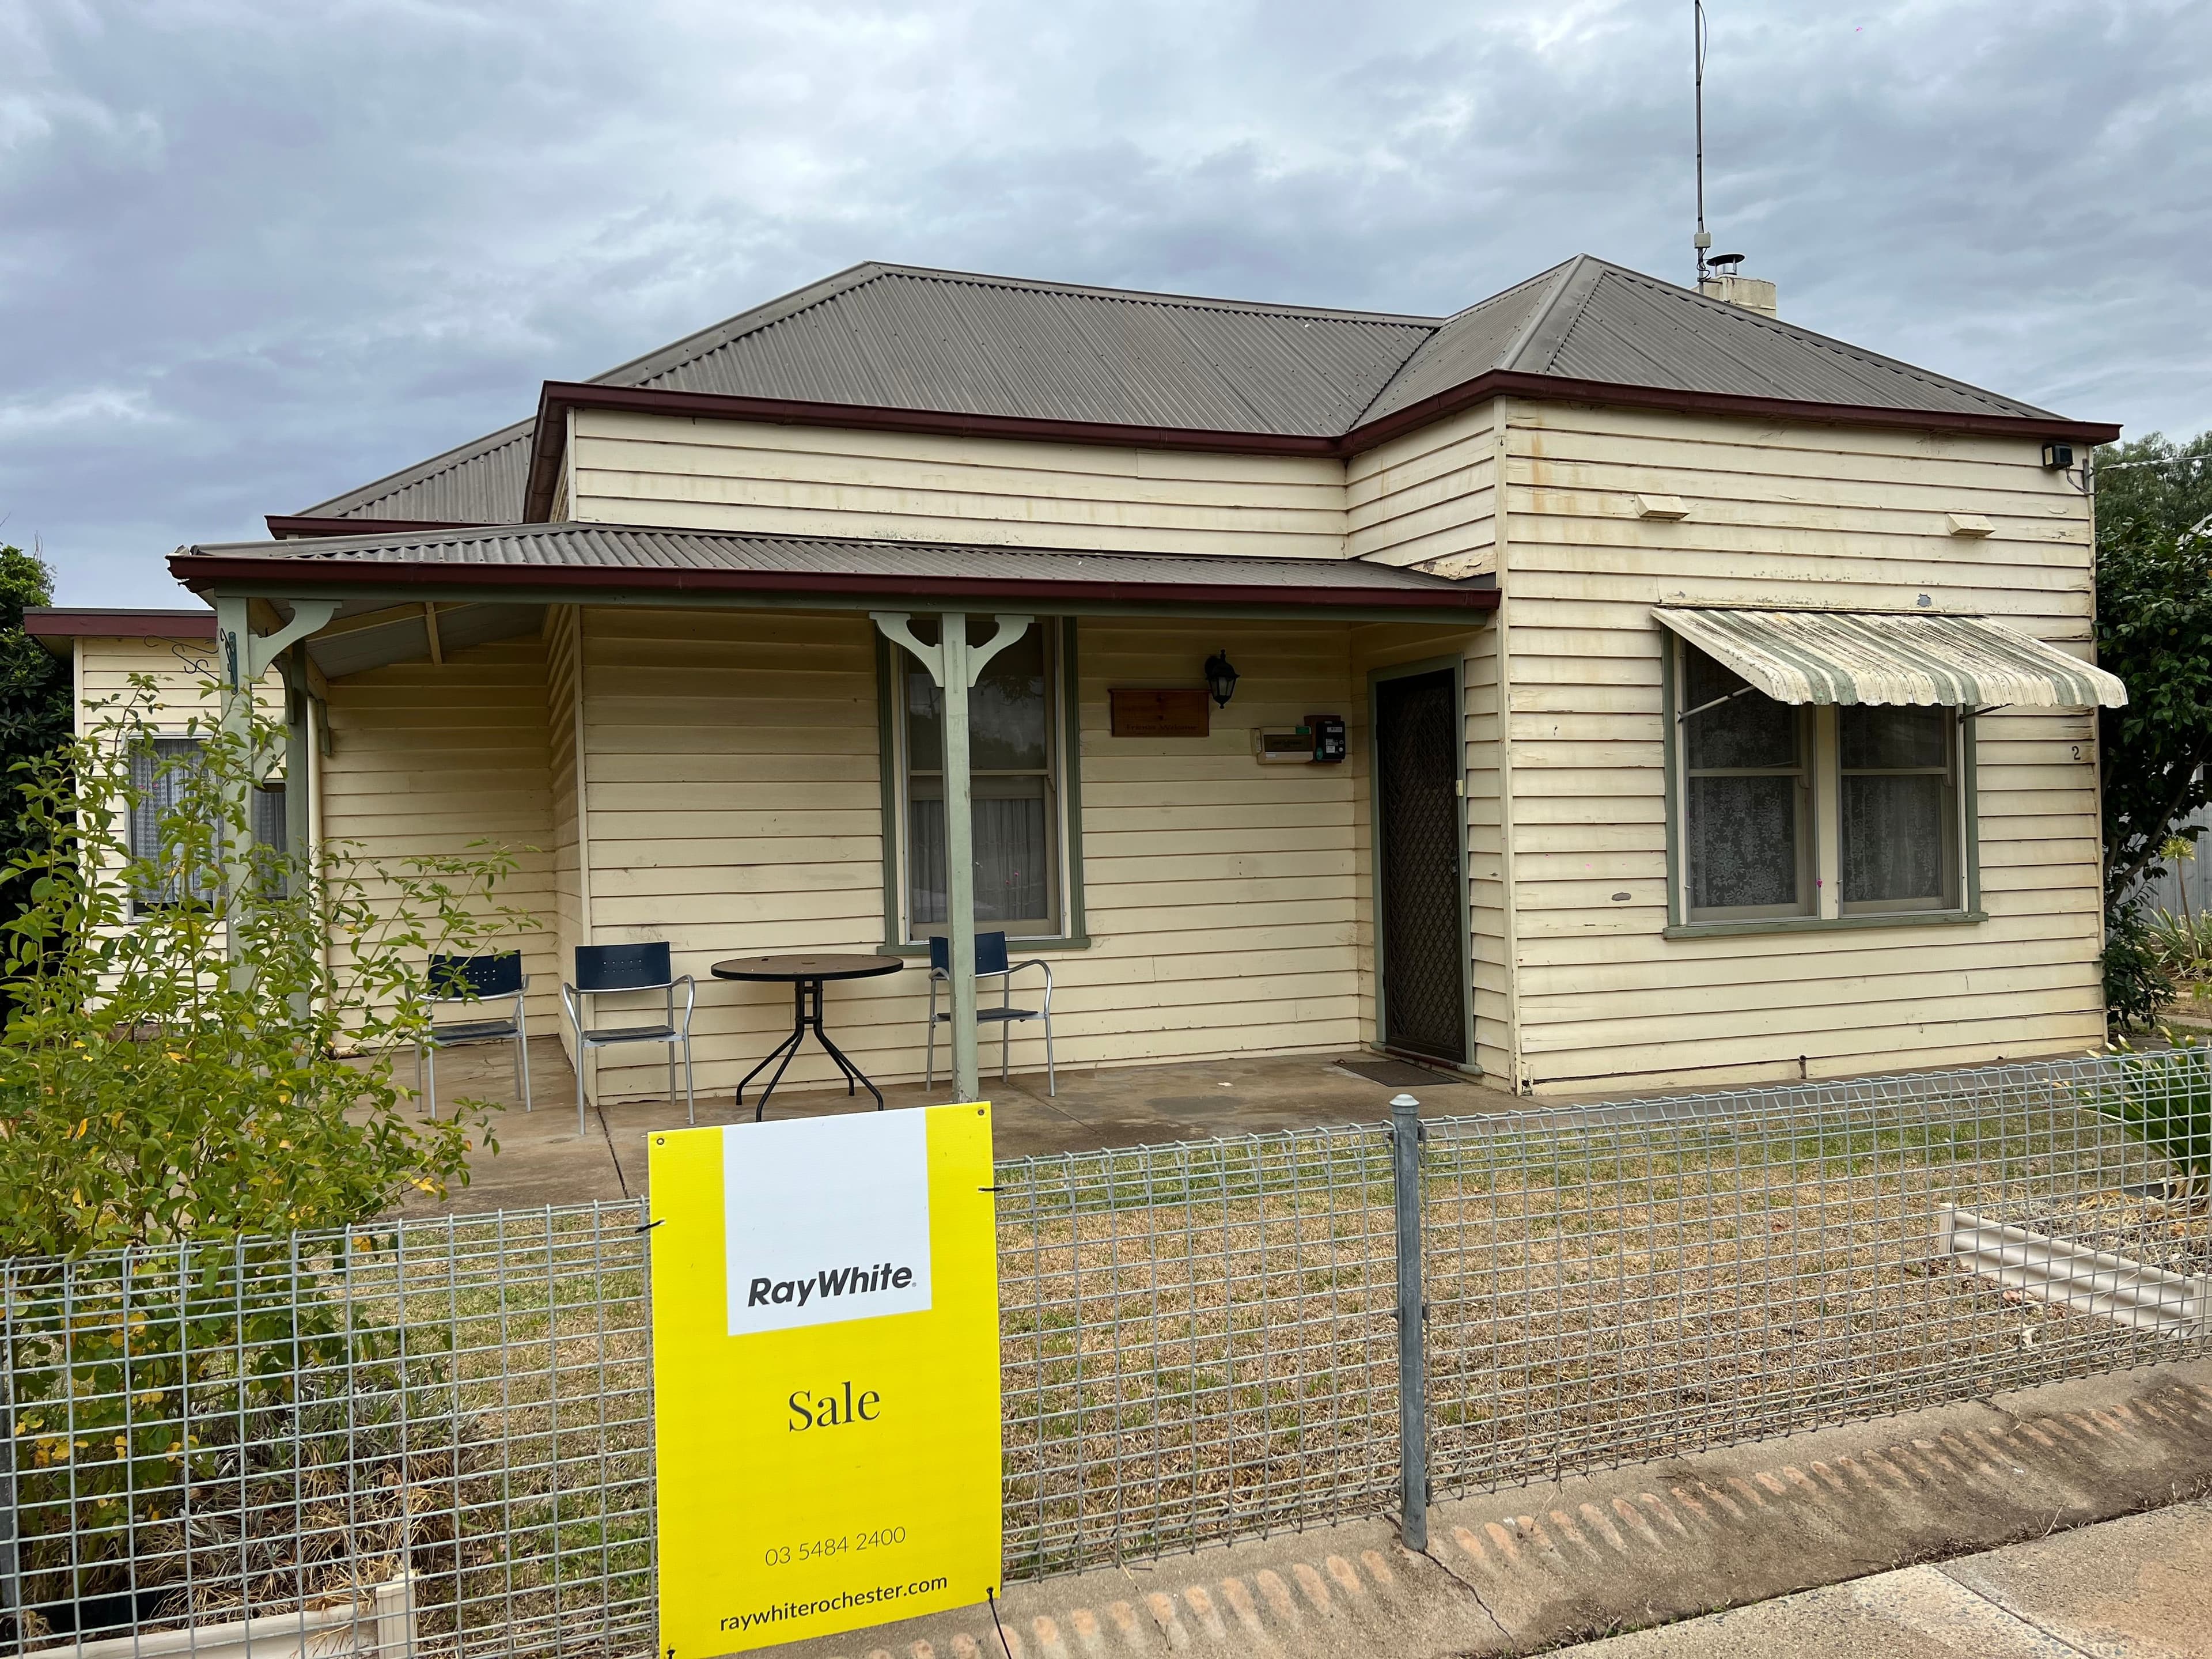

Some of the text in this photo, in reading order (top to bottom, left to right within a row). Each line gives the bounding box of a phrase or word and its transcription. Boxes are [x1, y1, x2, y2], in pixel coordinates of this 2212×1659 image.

[2071, 745, 2081, 760] 2
[789, 1381, 880, 1433] Sale
[765, 1526, 906, 1566] 03 5484 2400
[721, 1576, 948, 1632] raywhiterochester.com
